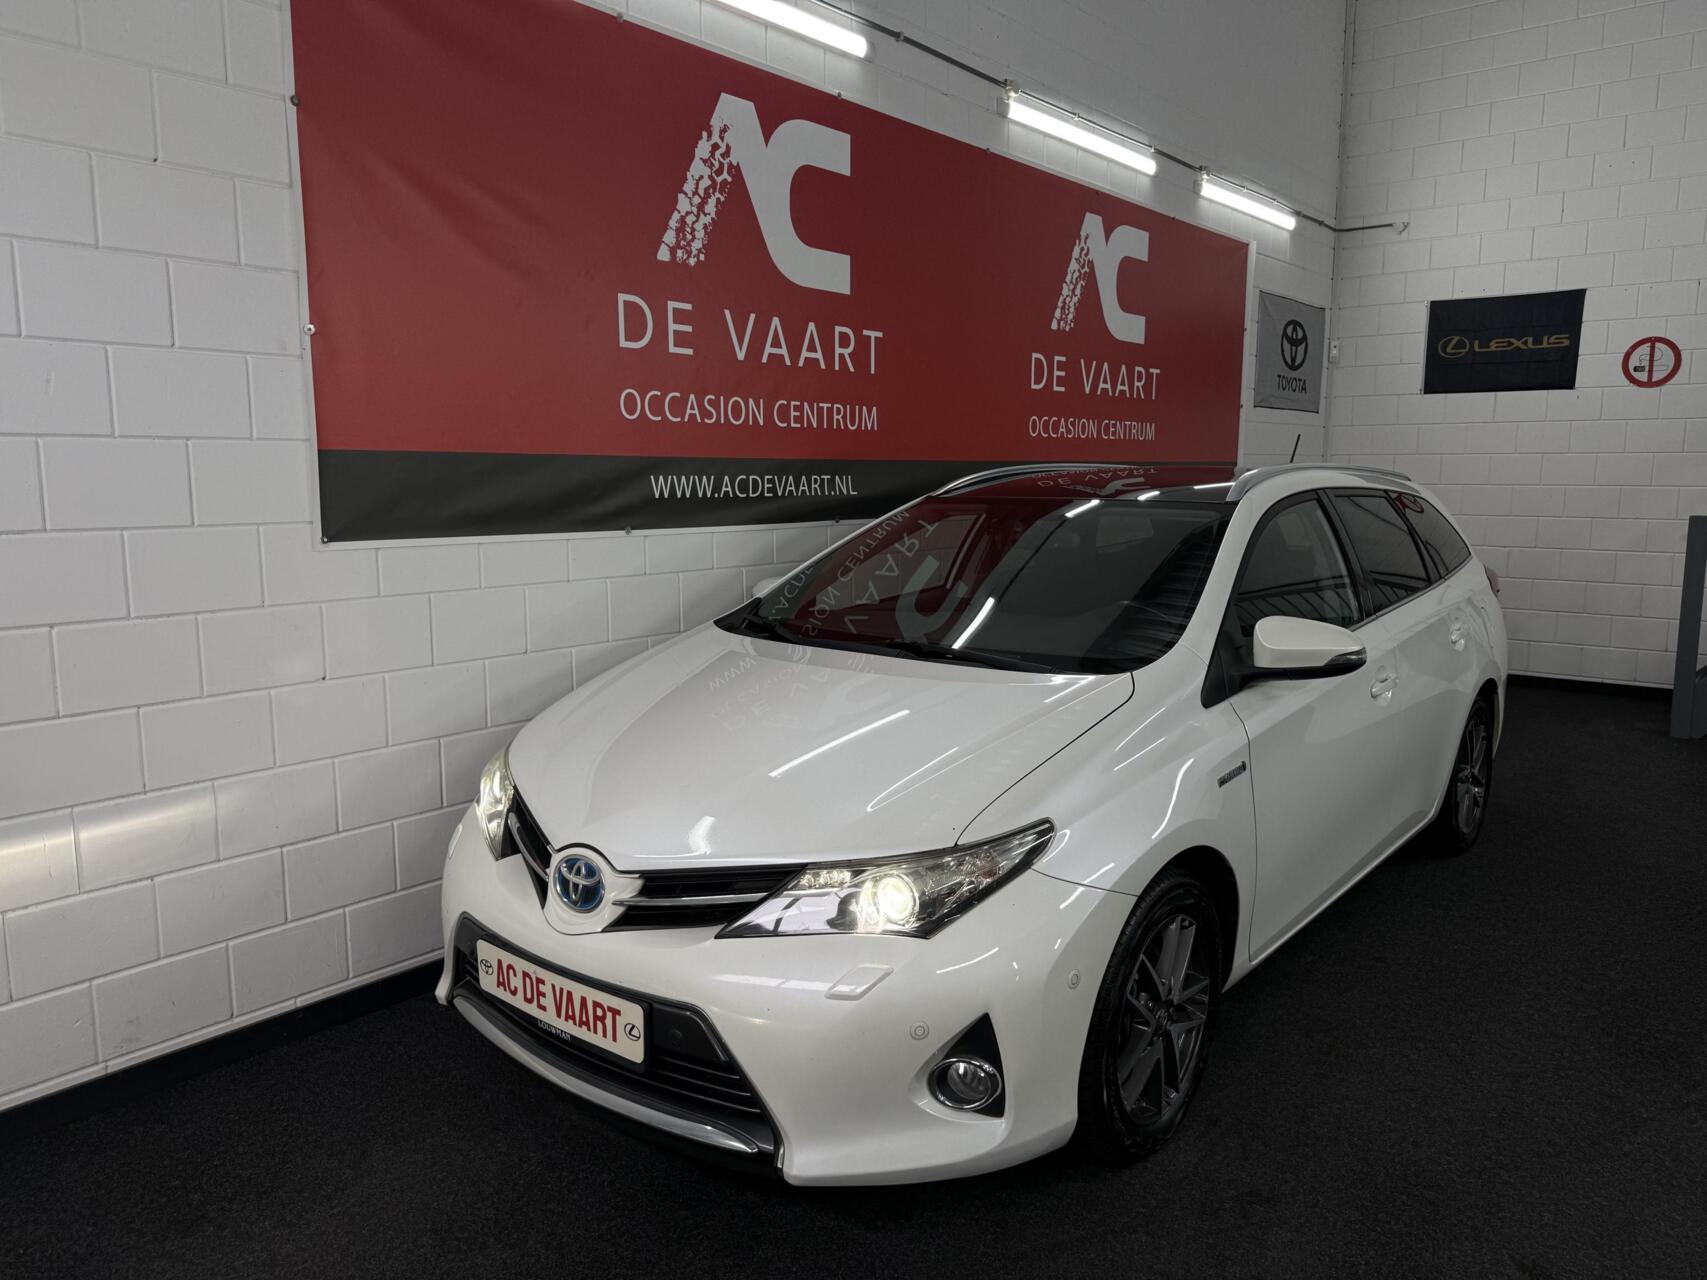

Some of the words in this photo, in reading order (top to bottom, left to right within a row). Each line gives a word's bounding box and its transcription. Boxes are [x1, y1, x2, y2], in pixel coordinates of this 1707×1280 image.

[617, 292, 694, 356] DE
[723, 308, 884, 375] VAART
[1473, 334, 1571, 353] LEXUS
[1030, 352, 1067, 392] DE
[1080, 358, 1161, 401] VAART
[1276, 373, 1307, 395] TOYOTA
[619, 387, 764, 427] OCCASION
[773, 399, 878, 432] CENTRUM
[1028, 415, 1098, 440] OCCASION
[1101, 419, 1156, 442] CENTRUM
[650, 474, 858, 499] WWW.ACDEVAART.NL
[496, 958, 518, 997] AC
[522, 969, 547, 1012] DE
[551, 983, 622, 1043] VAART
